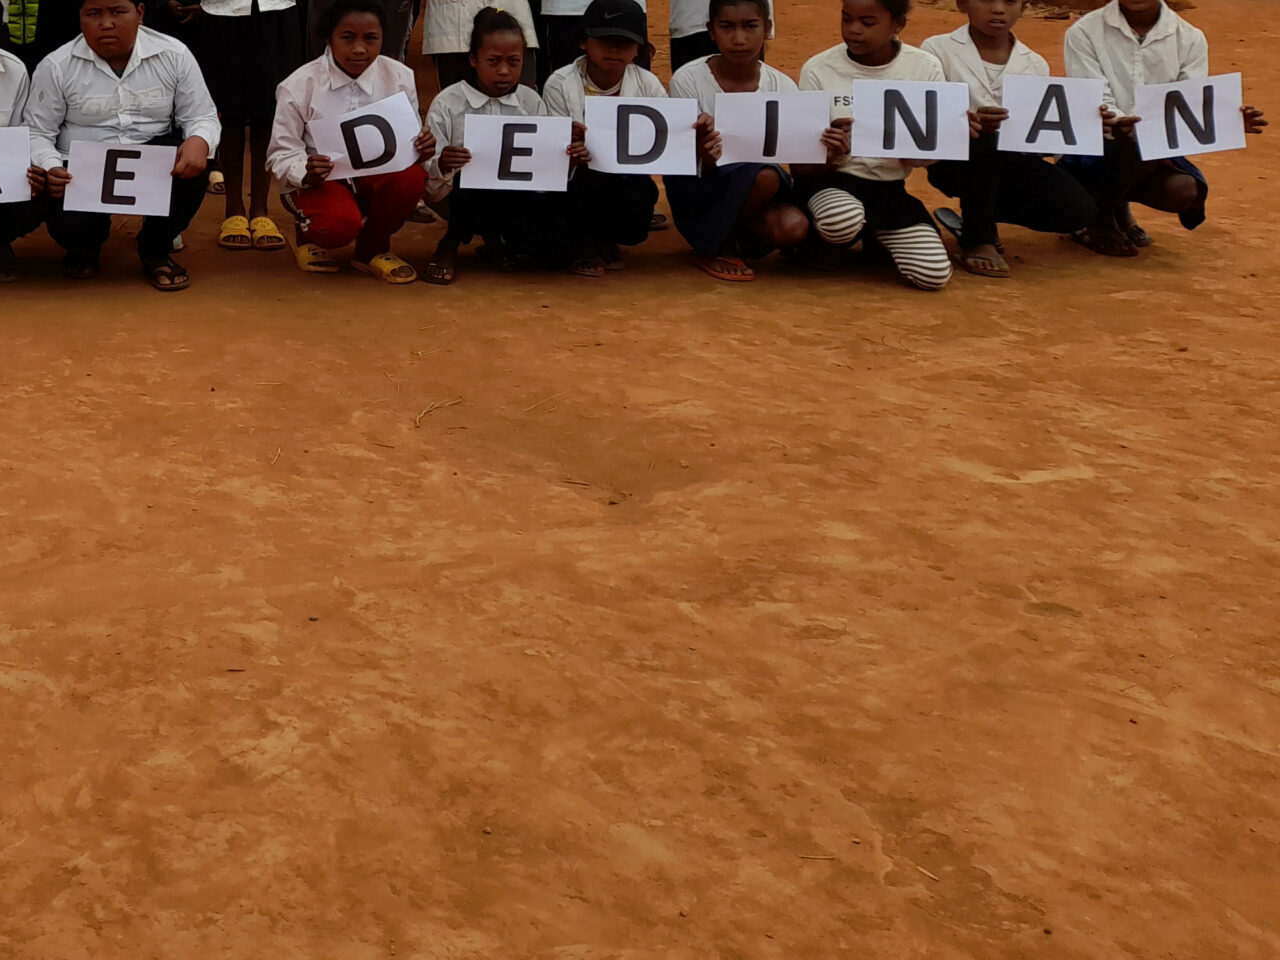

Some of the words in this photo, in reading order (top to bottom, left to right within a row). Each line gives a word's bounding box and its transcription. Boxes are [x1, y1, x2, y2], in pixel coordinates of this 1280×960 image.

[339, 113, 398, 171] D
[616, 103, 669, 165] D
[882, 88, 938, 152] N
[1024, 83, 1078, 146] A
[1164, 84, 1216, 150] N
[100, 148, 142, 206] E
[496, 122, 538, 182] E
